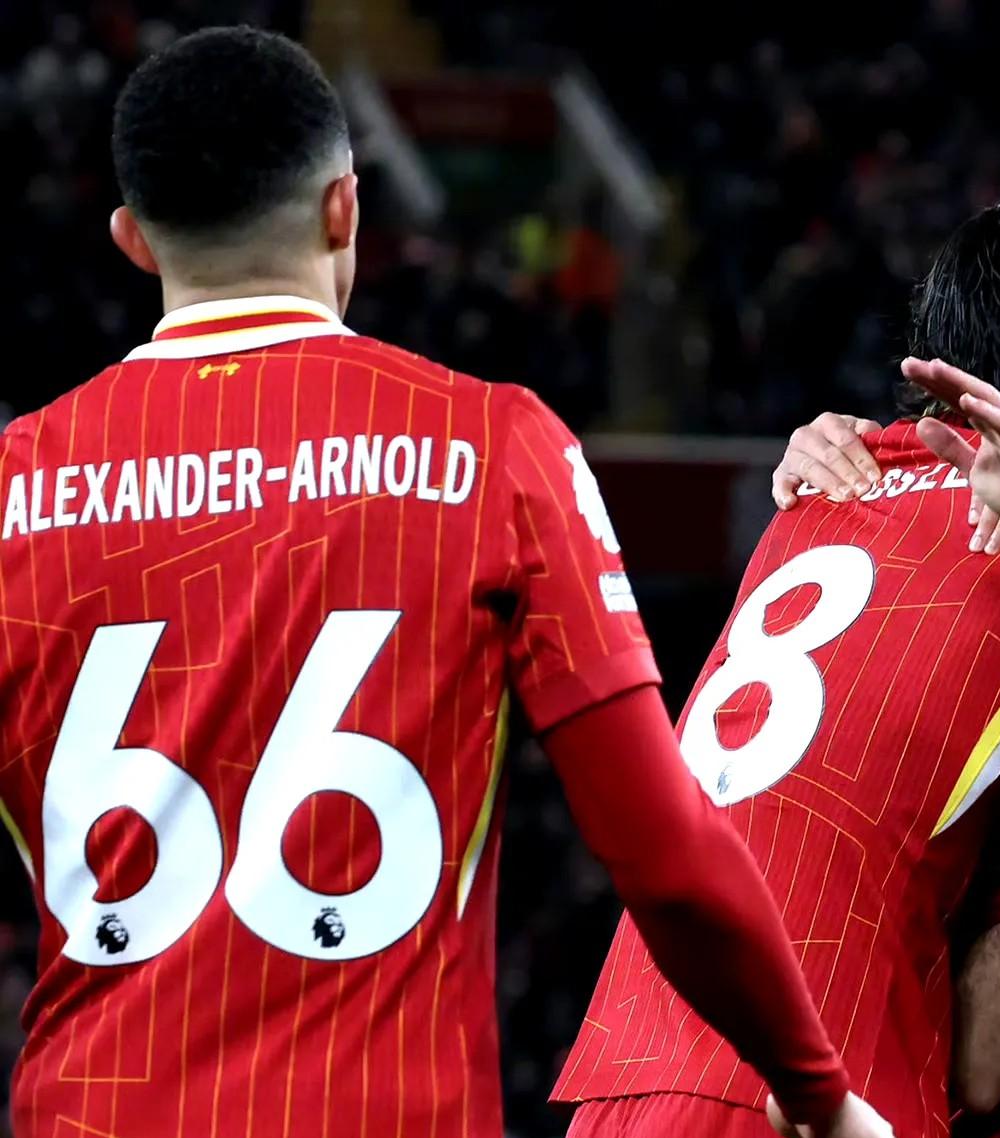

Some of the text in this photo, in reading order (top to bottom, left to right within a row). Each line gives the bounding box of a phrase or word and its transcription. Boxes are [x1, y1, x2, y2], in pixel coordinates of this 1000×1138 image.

[2, 435, 478, 541] ALEXANDER-ARNOLD
[42, 609, 443, 966] 66
[678, 543, 877, 807] 8
